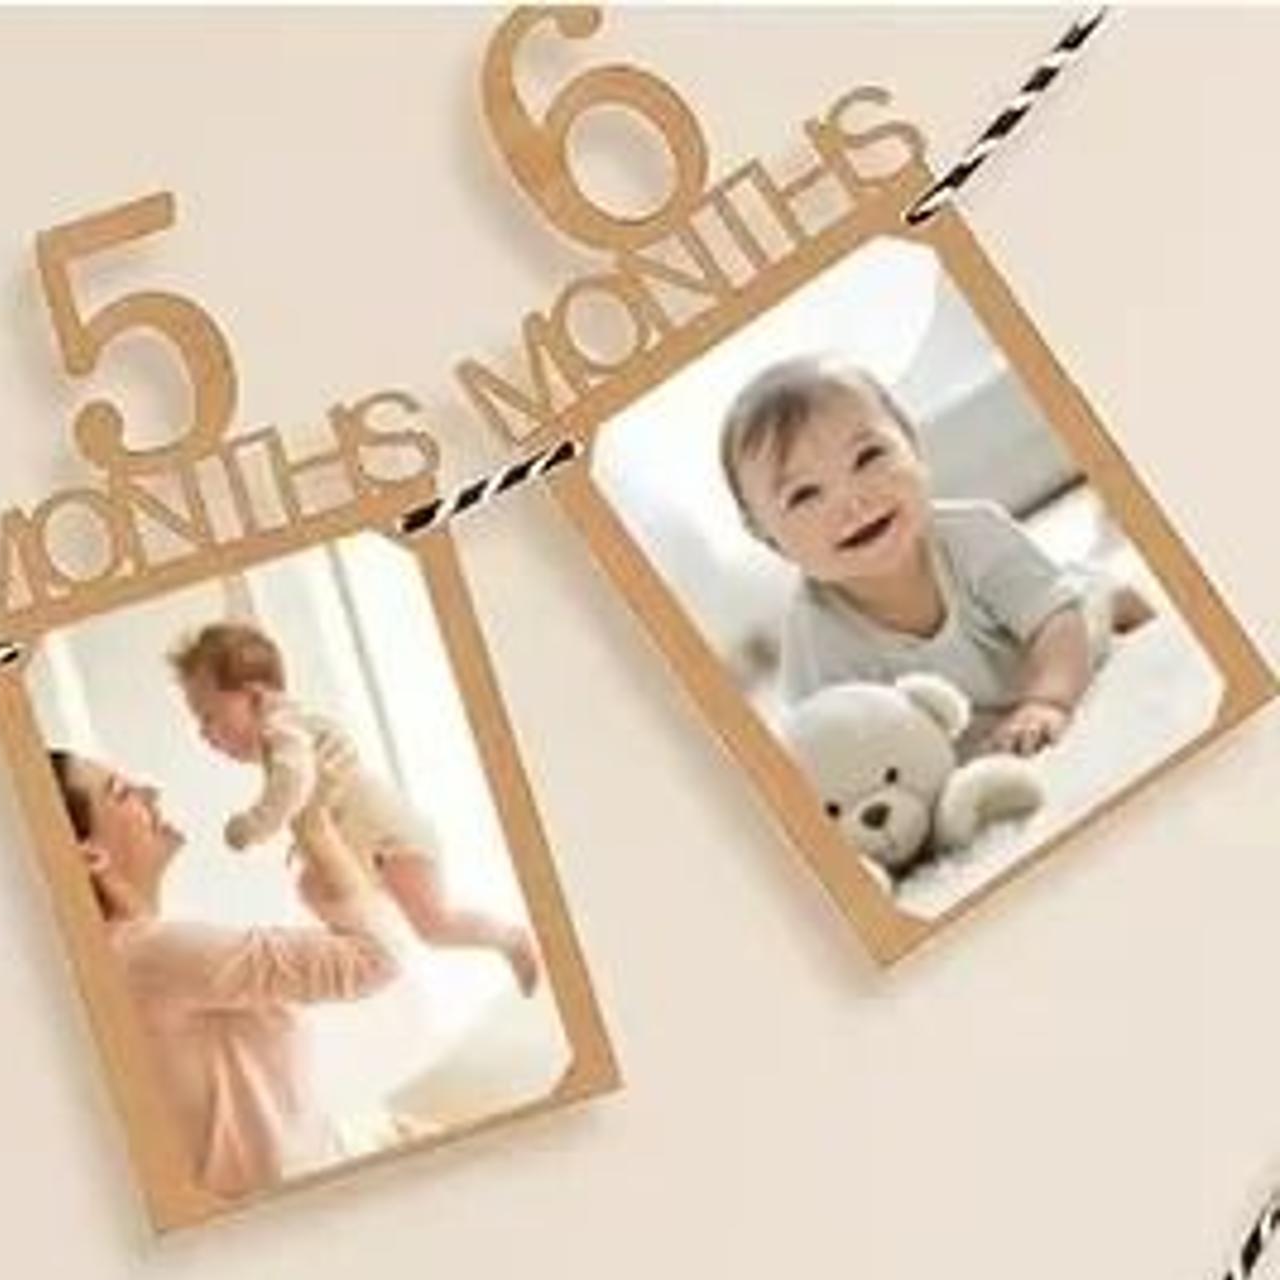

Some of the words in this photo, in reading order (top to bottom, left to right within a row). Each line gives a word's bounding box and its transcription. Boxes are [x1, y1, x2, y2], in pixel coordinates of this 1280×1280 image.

[457, 86, 928, 445] MONTHS
[481, 3, 708, 256] 6
[38, 191, 237, 471] 5
